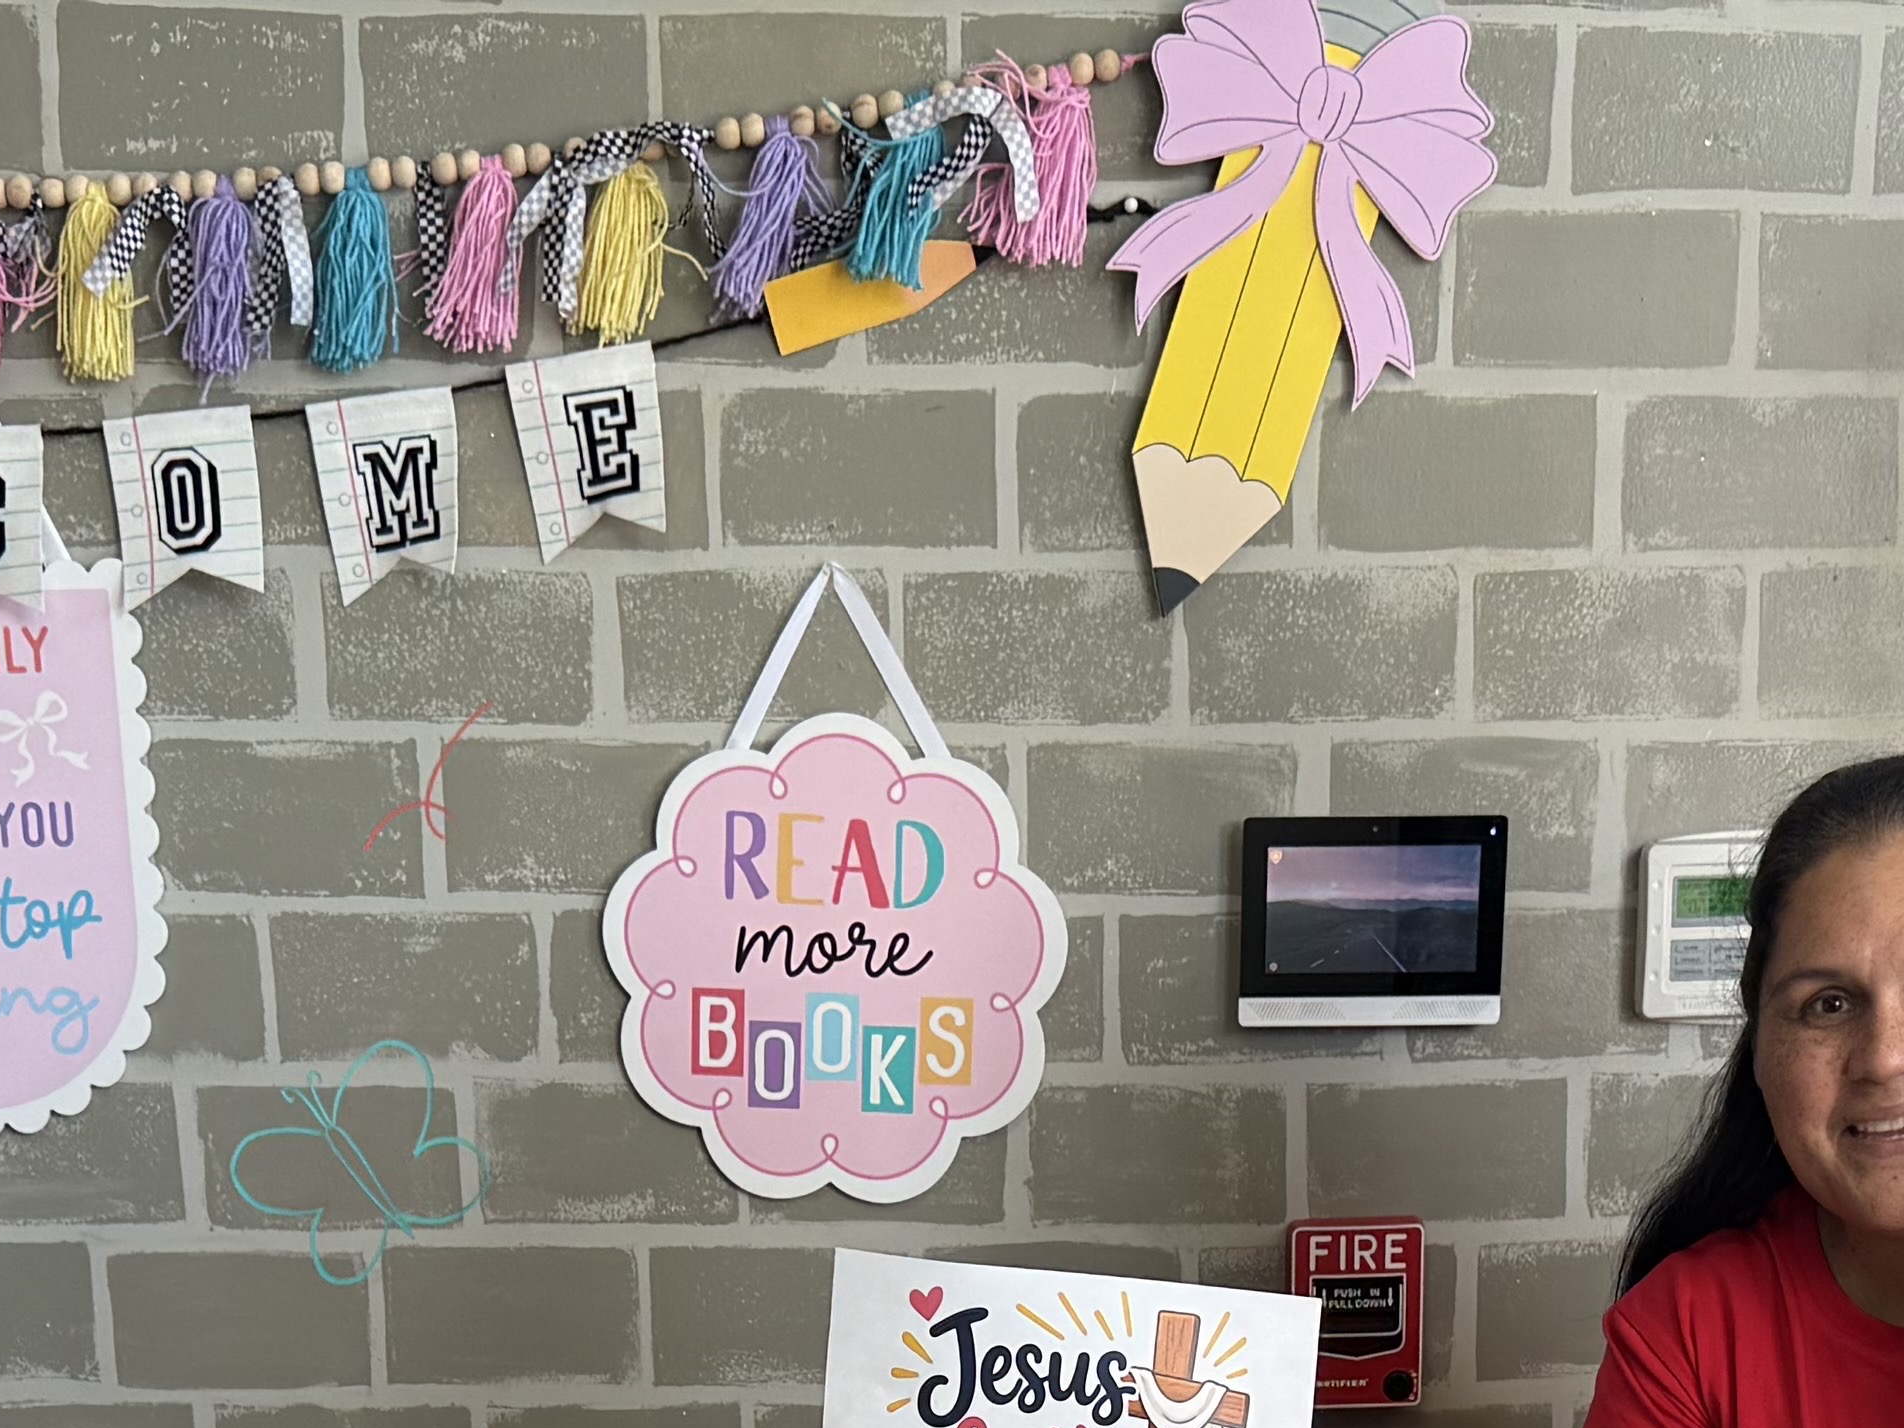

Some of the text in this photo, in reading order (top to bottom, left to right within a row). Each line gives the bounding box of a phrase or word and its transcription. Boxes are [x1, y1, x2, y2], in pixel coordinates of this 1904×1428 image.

[724, 810, 945, 909] READ
[734, 921, 934, 978] more
[698, 995, 967, 1107] BOOKS
[1309, 1233, 1408, 1271] FIRE
[1328, 1299, 1386, 1309] PULL DOWN
[1333, 1288, 1380, 1298] PUSH IN
[917, 1307, 1139, 1428] Jesus
